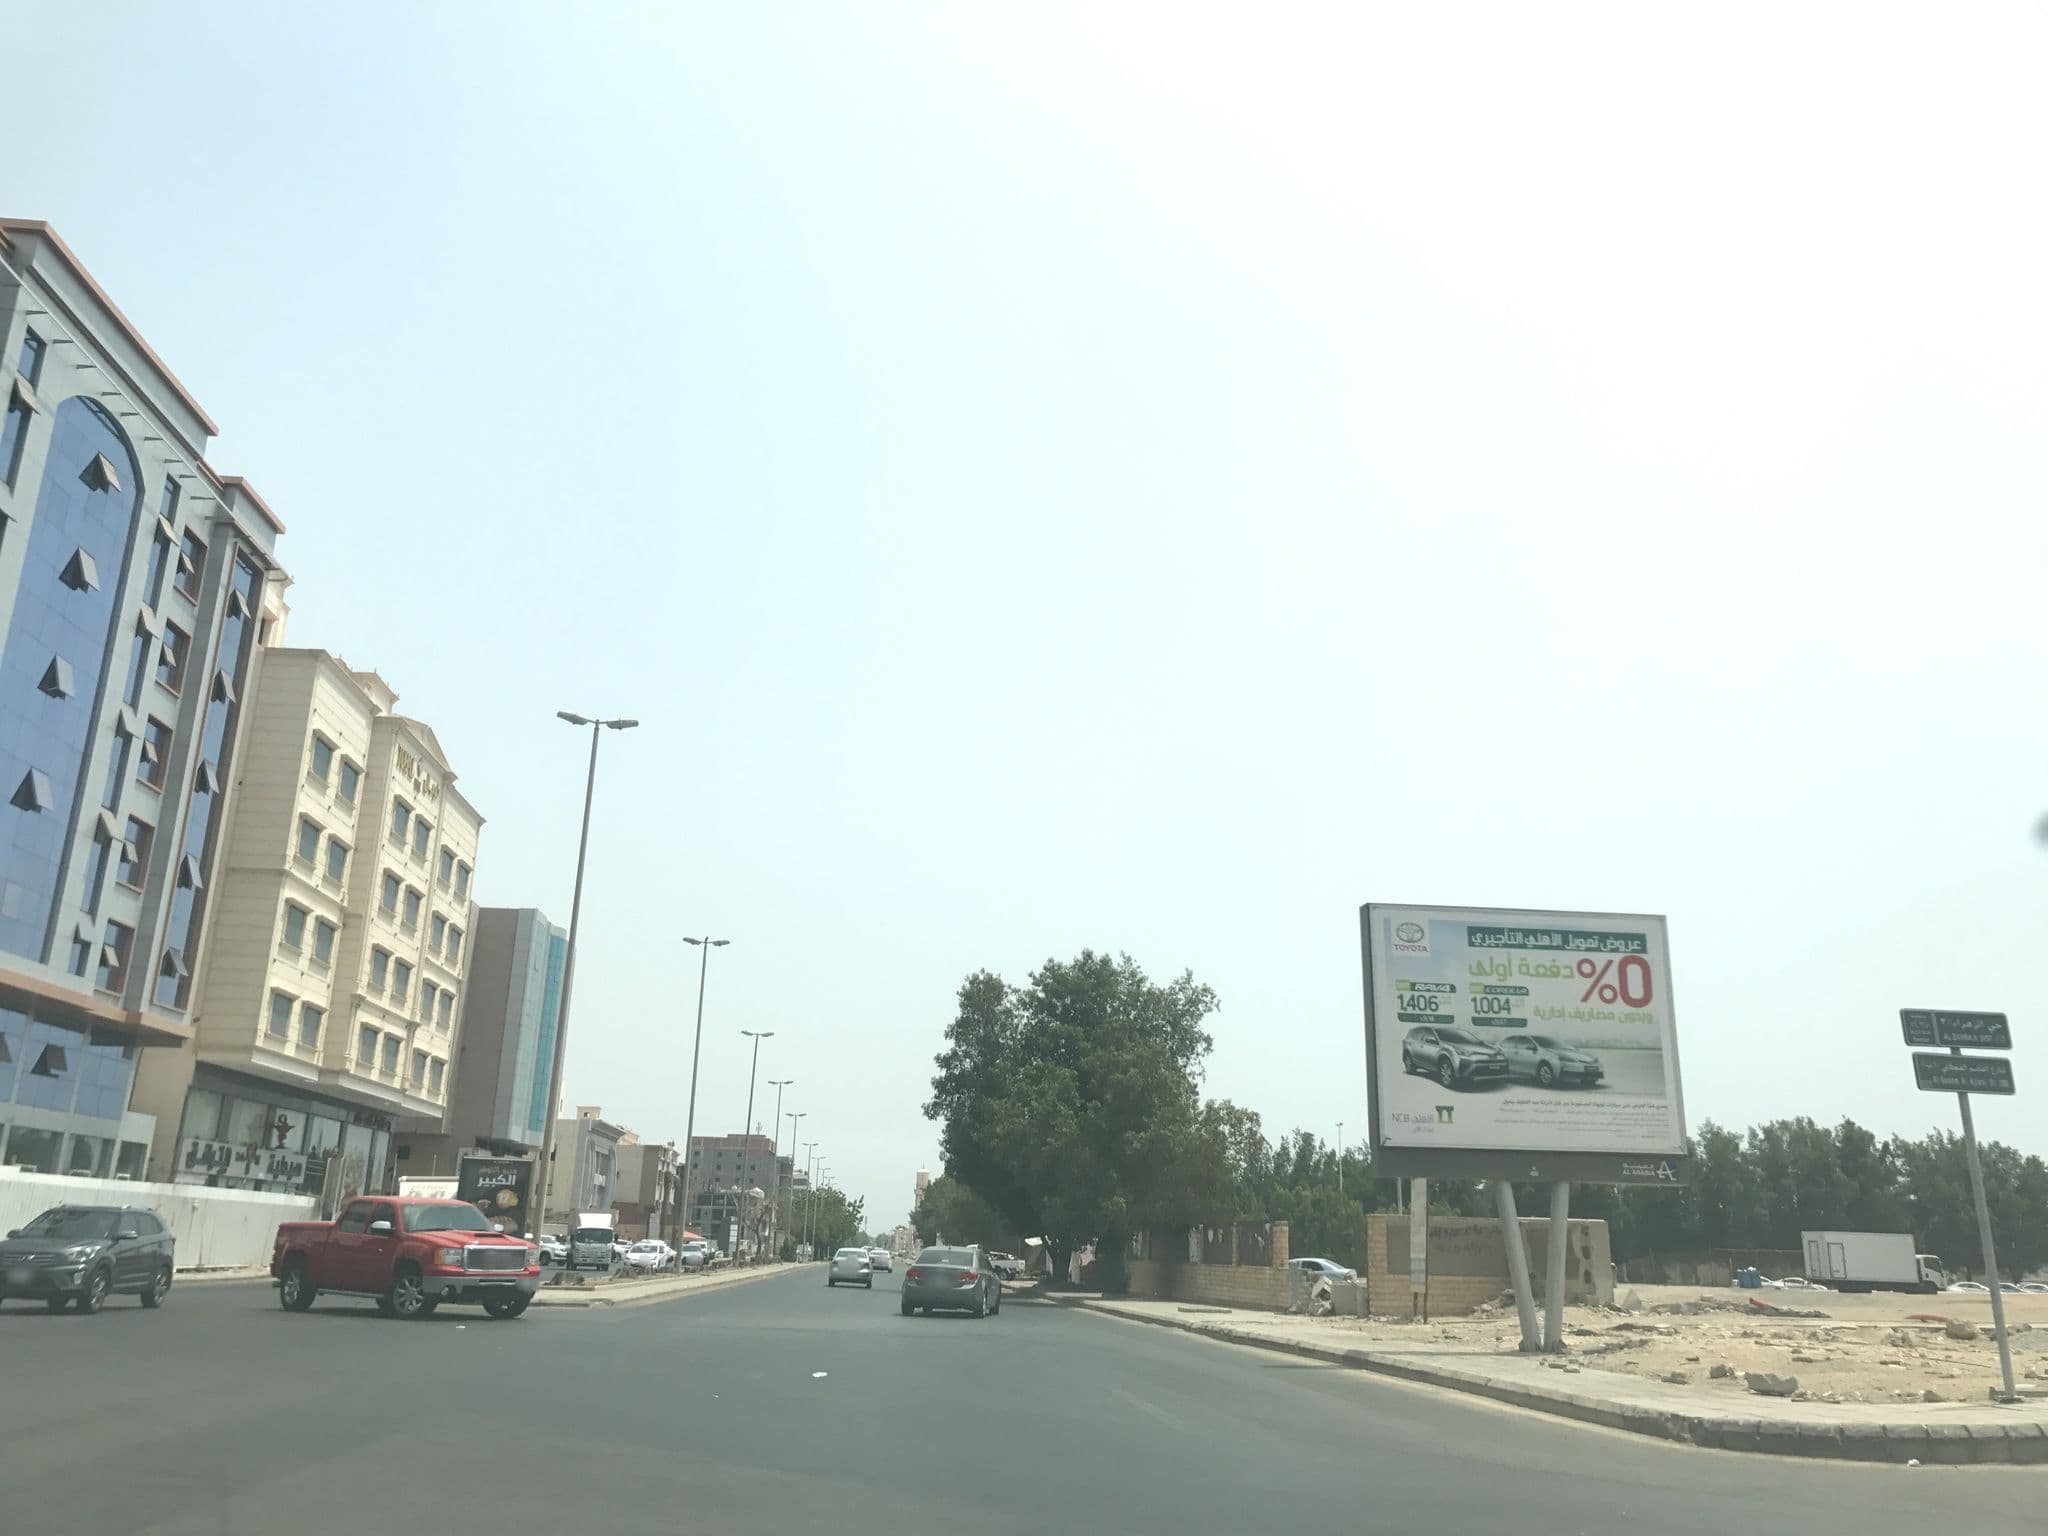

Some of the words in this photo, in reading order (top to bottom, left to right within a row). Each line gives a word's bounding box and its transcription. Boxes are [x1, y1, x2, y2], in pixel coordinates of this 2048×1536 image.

[1471, 930, 1524, 946] التأجيري
[1564, 934, 1600, 950] تمويل
[1600, 937, 1642, 951] عروض
[1394, 944, 1429, 953] TOYOTA
[1468, 952, 1513, 982] أولى
[1518, 956, 1576, 980] دفعة
[1414, 983, 1451, 993] RAV4
[477, 1174, 516, 1188] الكبير
